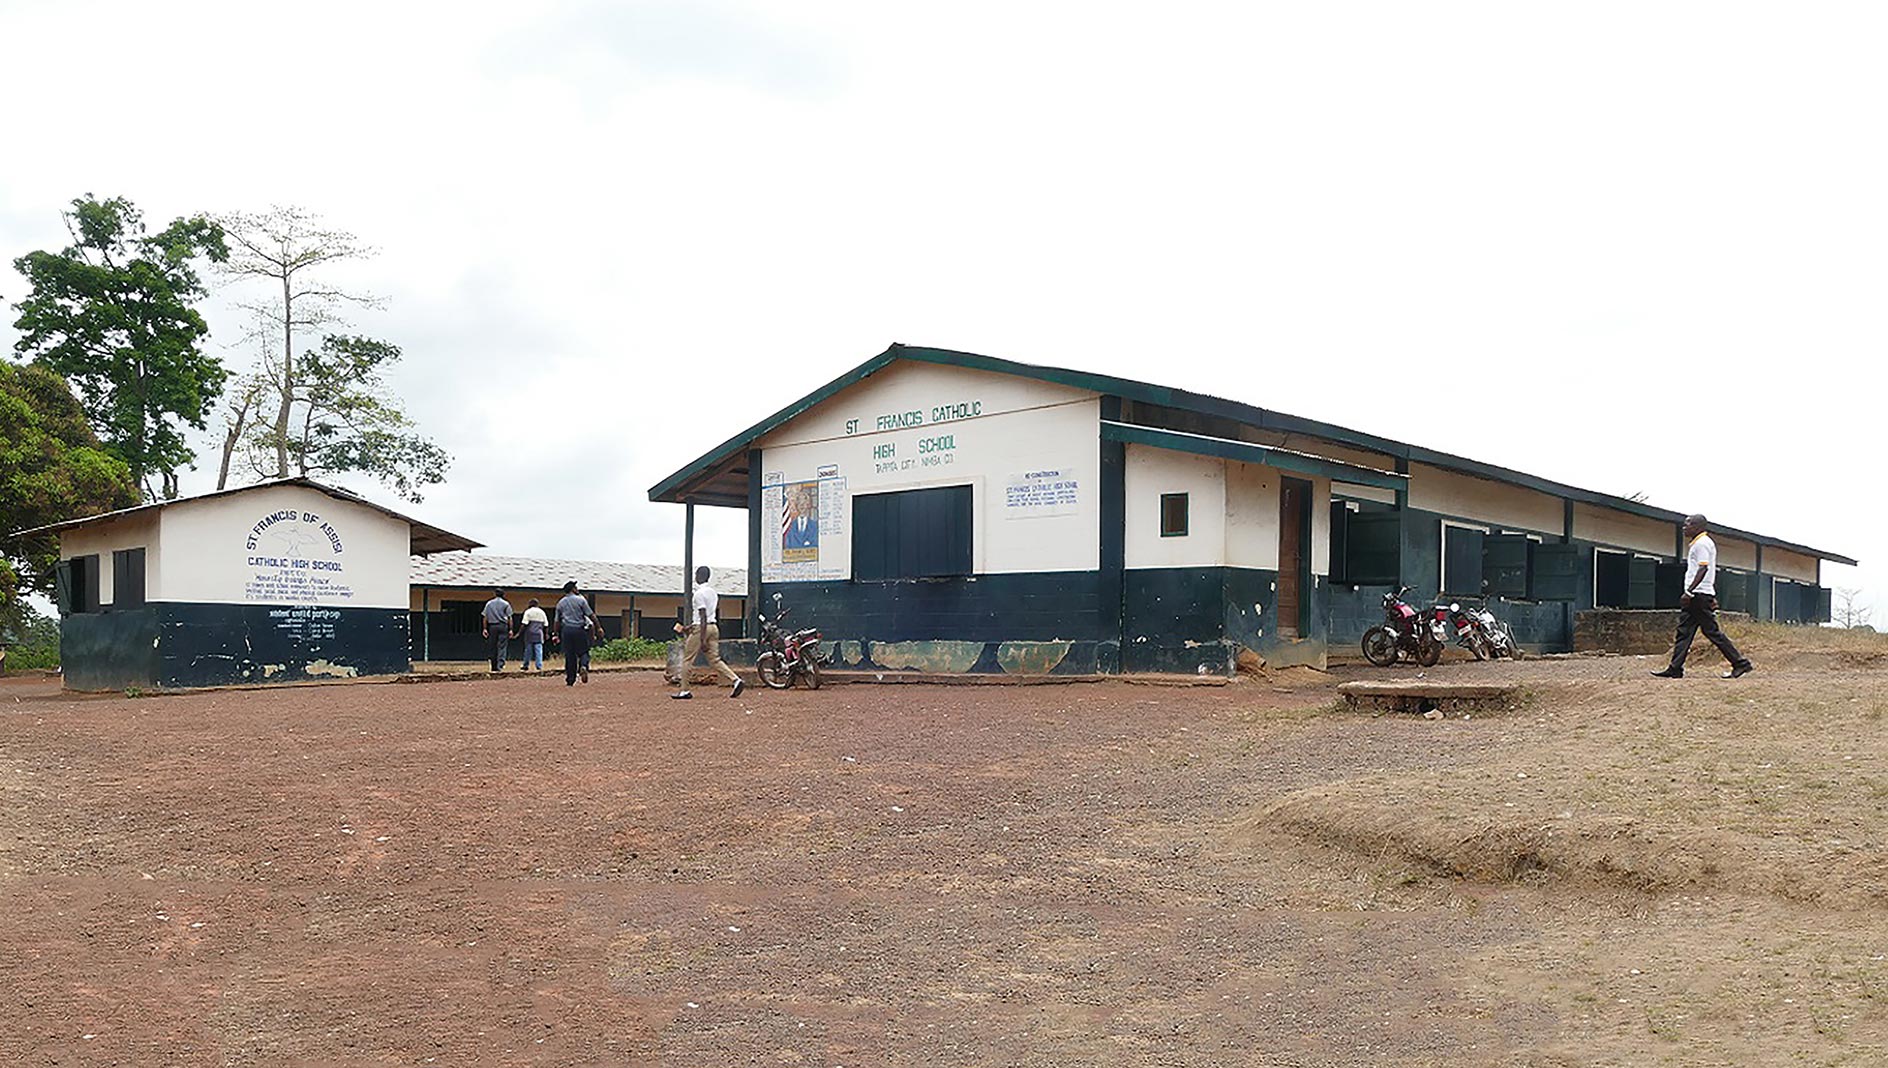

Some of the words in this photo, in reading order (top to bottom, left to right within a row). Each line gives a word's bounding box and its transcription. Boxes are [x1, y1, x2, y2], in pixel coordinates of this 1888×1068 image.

[846, 419, 859, 434] ST
[877, 410, 923, 430] FRANCIS
[931, 401, 982, 422] CATHOLIC
[873, 443, 895, 460] HIGH
[918, 435, 956, 454] SCHOOL
[252, 510, 298, 536] FRANCIS
[302, 512, 319, 524] OF
[319, 522, 343, 554] ASSISI
[248, 557, 289, 568] CATHOLIC
[291, 559, 309, 569] HIGH
[312, 560, 343, 572] SCHOOL
